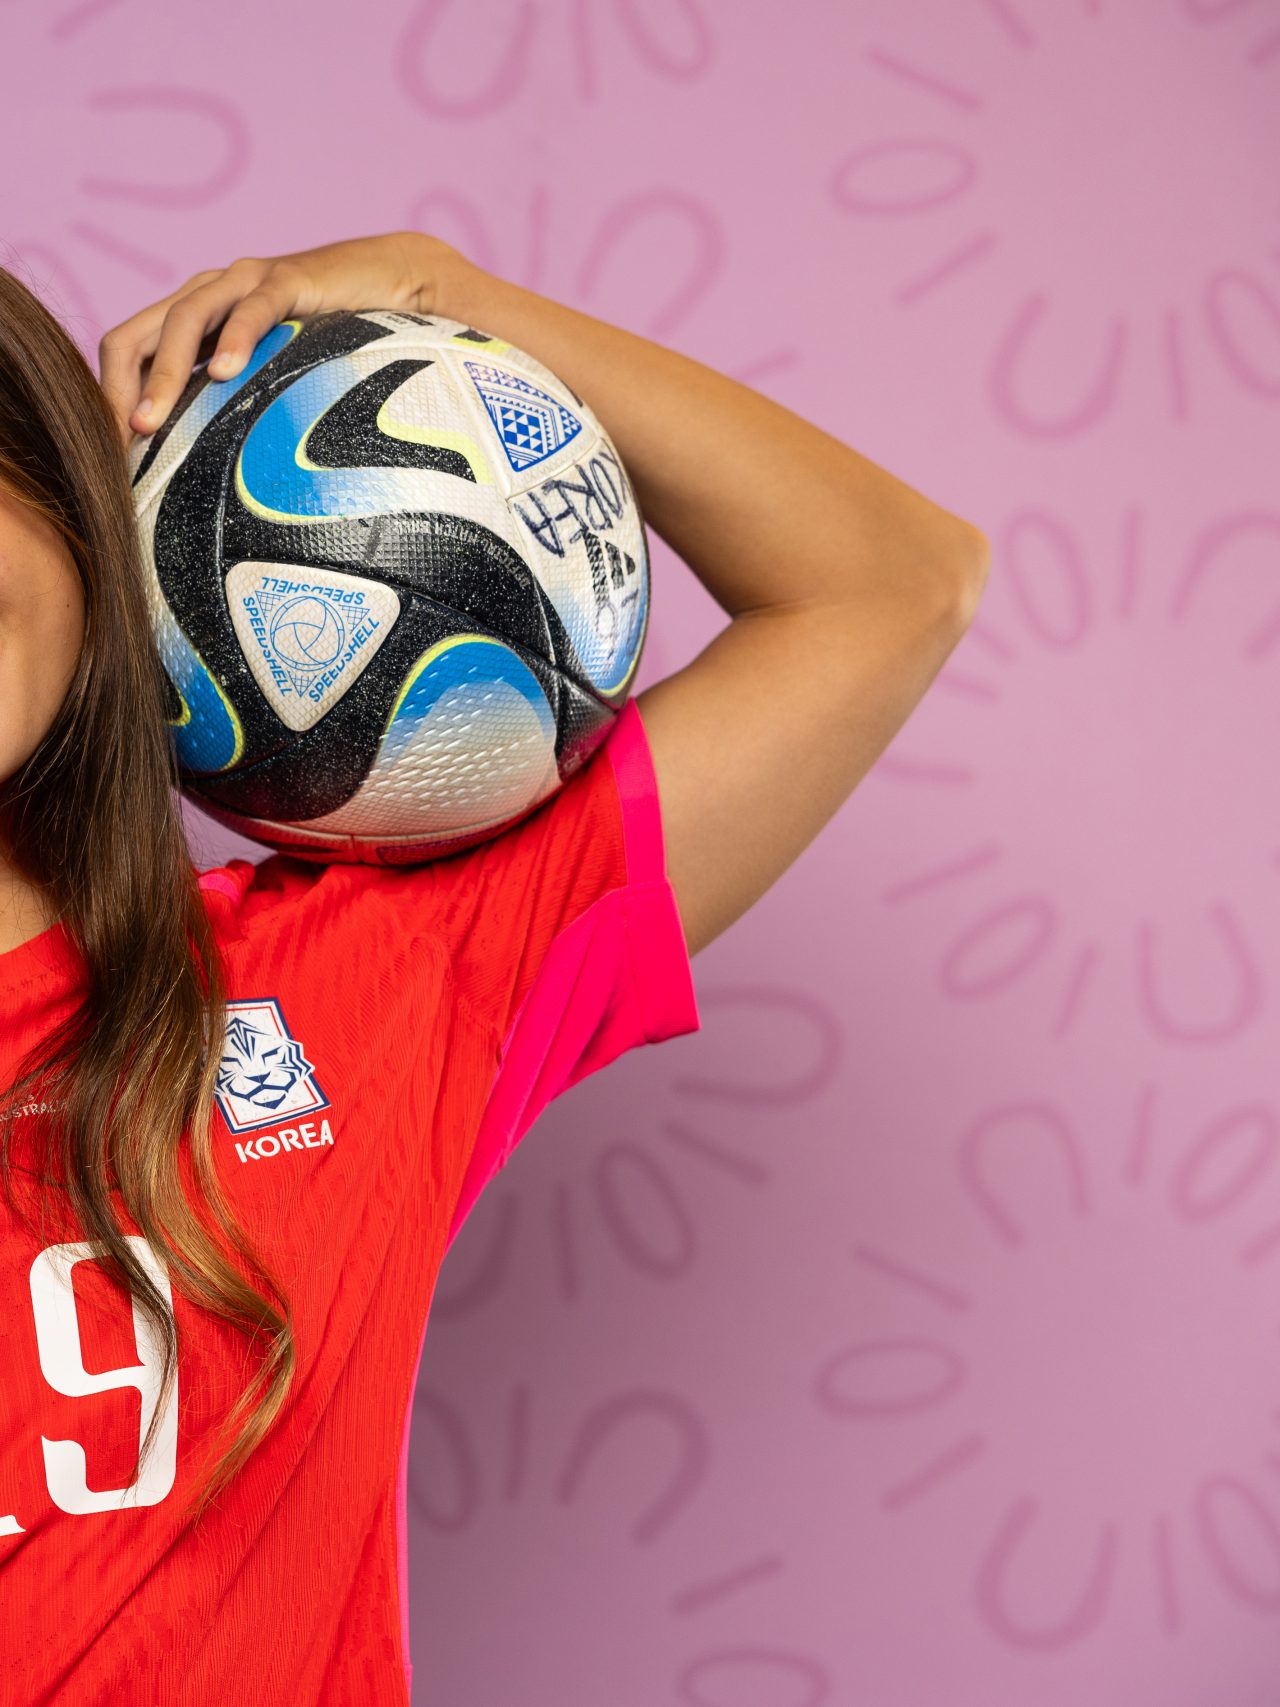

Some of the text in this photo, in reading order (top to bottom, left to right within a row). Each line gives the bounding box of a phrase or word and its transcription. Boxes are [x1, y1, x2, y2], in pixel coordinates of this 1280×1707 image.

[513, 437, 632, 558] KOREA
[434, 521, 479, 545] MATCH
[482, 537, 531, 588] OFFICIAL
[261, 576, 366, 605] SPEEDSHELL
[243, 596, 293, 697] SPEEDSHELL
[309, 617, 380, 703] SPEEDSHELL
[234, 1119, 335, 1163] KOREA
